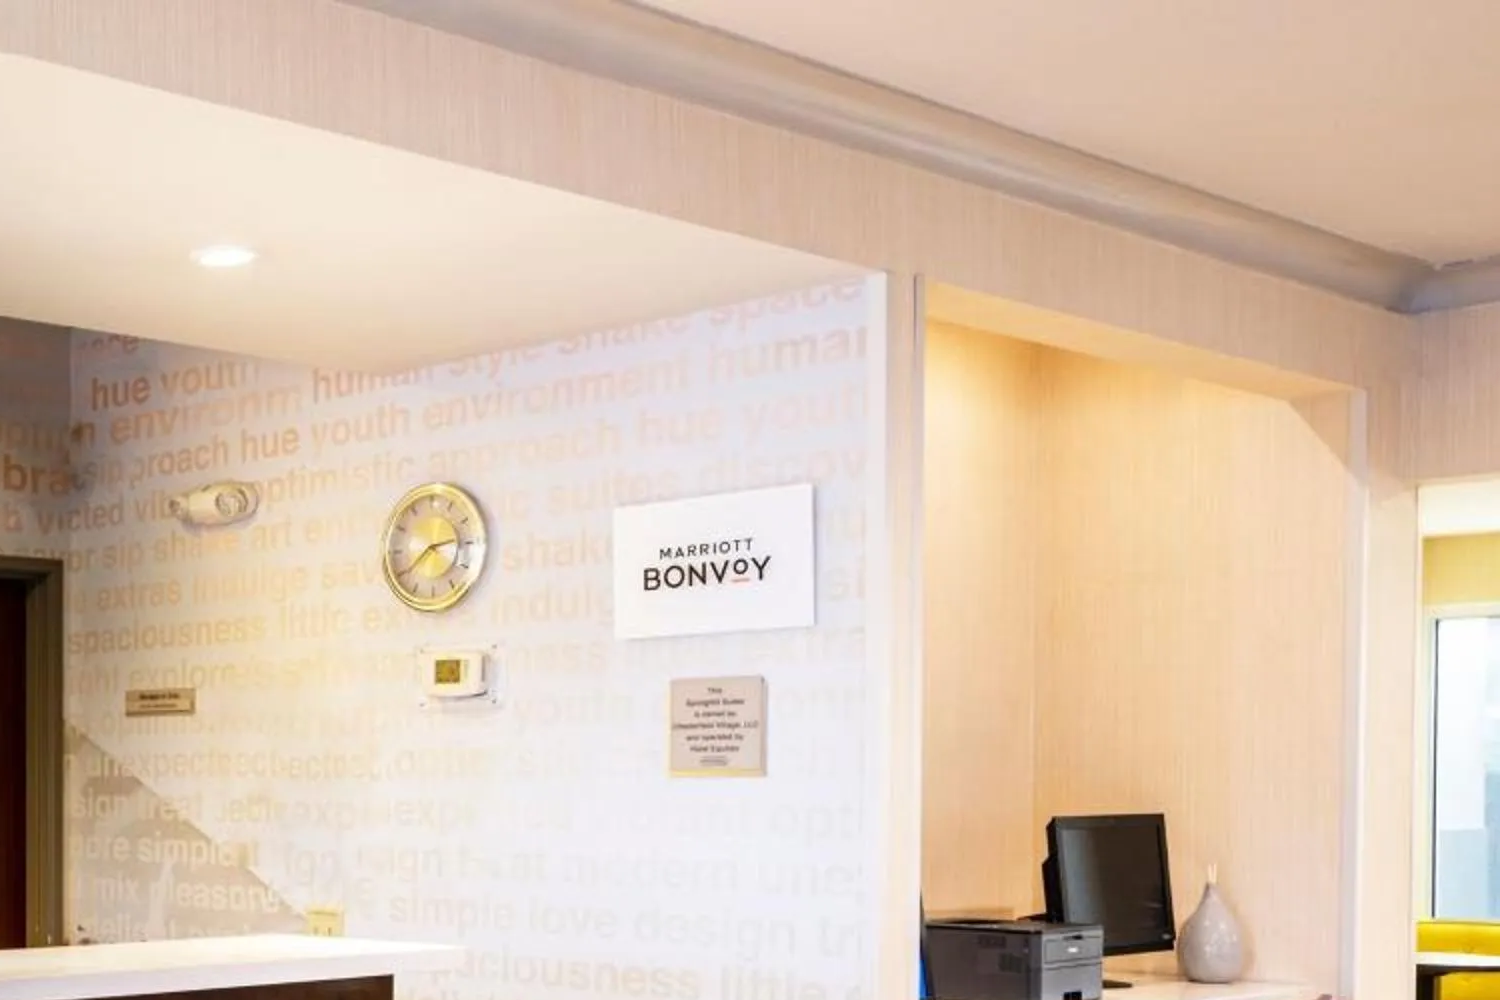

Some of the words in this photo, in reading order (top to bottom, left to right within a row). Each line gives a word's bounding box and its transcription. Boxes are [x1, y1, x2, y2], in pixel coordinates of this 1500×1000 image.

[89, 376, 151, 411] hue
[240, 425, 300, 463] hue
[311, 402, 411, 457] youth
[422, 354, 690, 430] environment
[636, 406, 727, 448] hue
[99, 578, 181, 610] extras
[503, 526, 613, 573] shak
[659, 538, 753, 560] MARRIOTT
[643, 555, 771, 591] BONVOY
[67, 611, 267, 656] spaciousness
[528, 898, 620, 941] love
[633, 906, 797, 963] design
